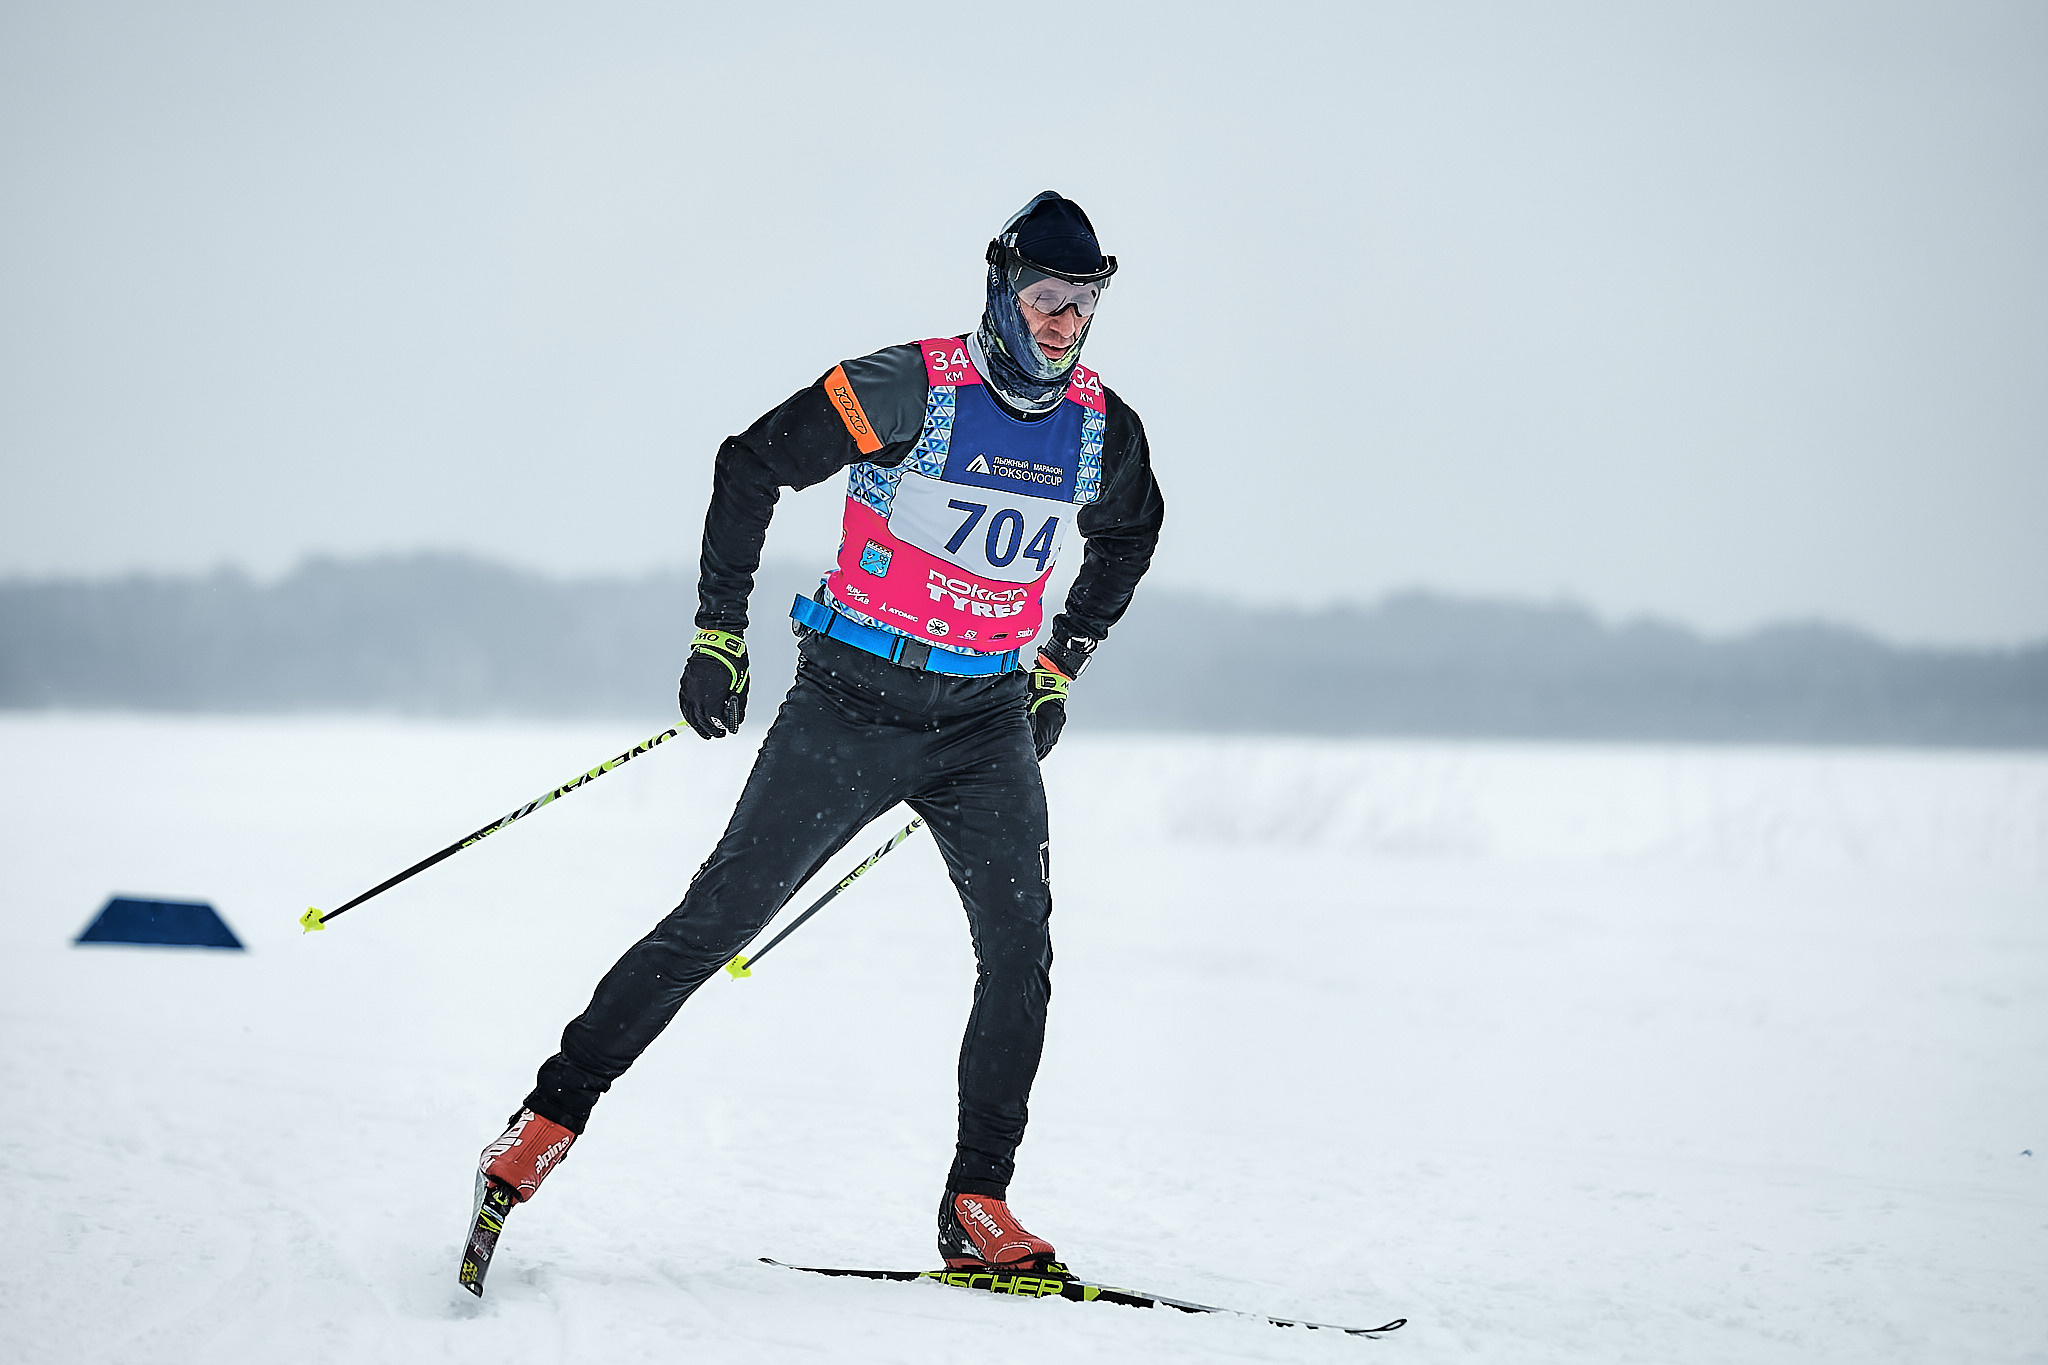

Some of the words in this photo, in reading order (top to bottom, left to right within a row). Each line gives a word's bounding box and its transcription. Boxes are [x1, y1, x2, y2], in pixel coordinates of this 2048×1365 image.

[929, 348, 969, 371] 34
[1071, 365, 1102, 396] 34
[944, 499, 1060, 571] 704
[888, 607, 919, 622] ATOMIC
[926, 583, 1026, 618] TYRES
[534, 1135, 570, 1174] alpina
[962, 1198, 1004, 1239] alpina
